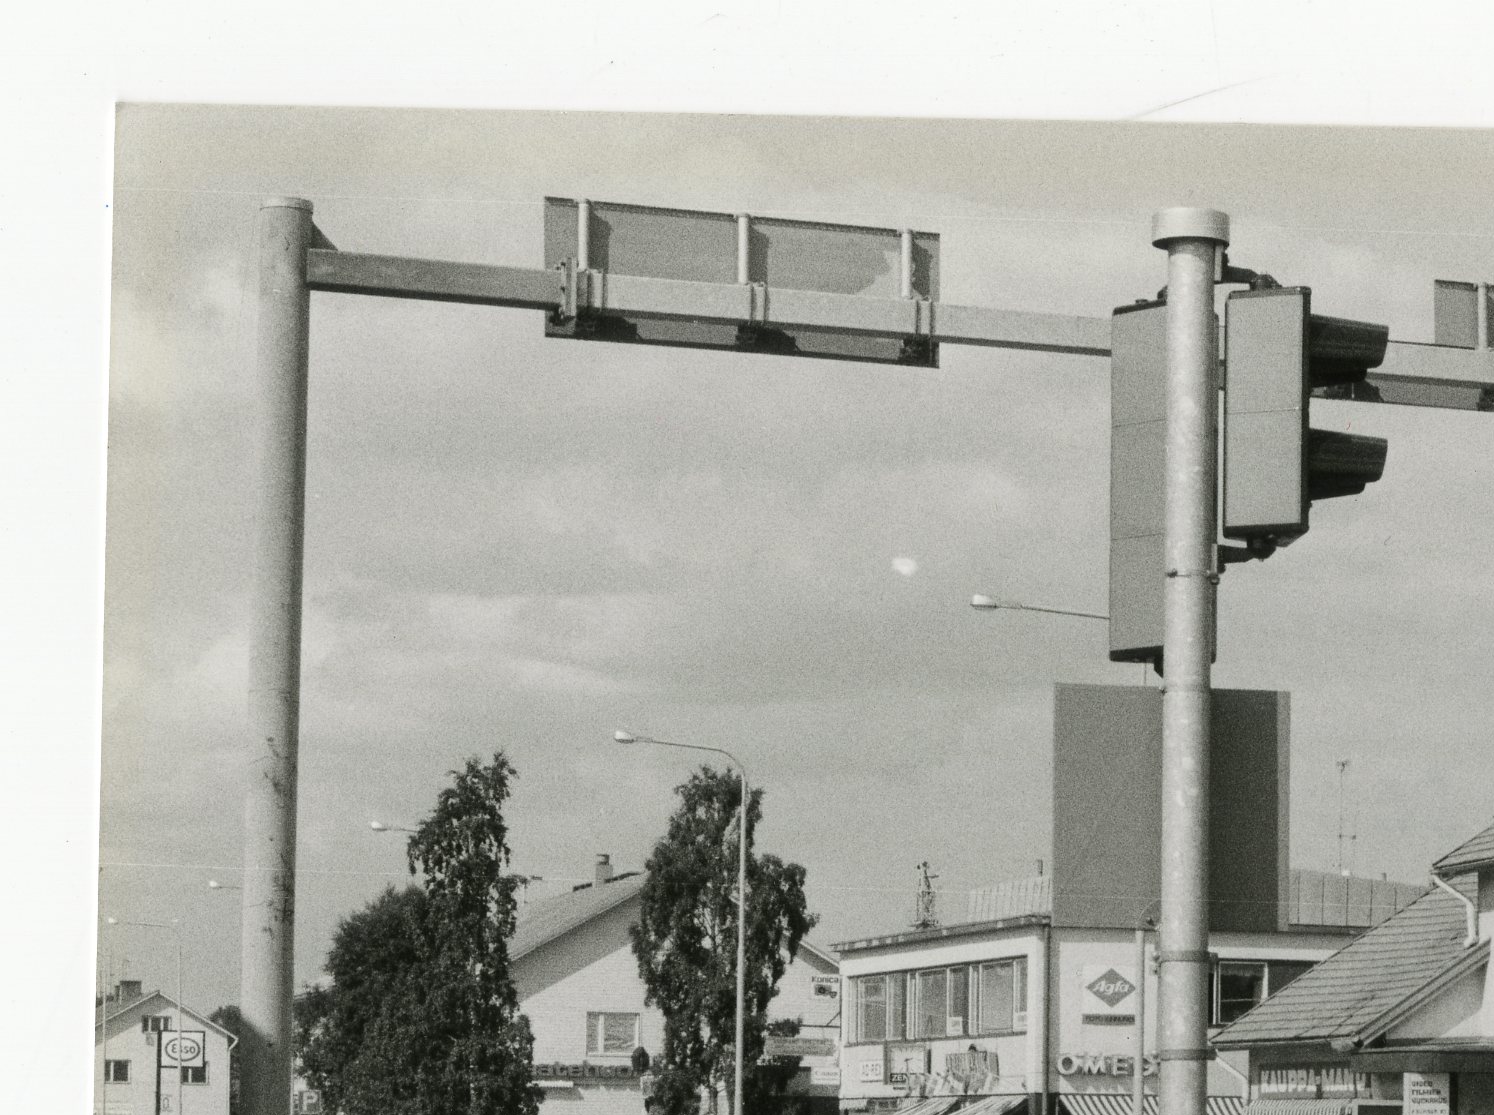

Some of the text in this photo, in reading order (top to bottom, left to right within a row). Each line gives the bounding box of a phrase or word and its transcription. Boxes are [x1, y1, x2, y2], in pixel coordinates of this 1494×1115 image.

[811, 975, 840, 983] Konica
[1093, 980, 1129, 995] Agfa
[303, 1092, 318, 1111] P
